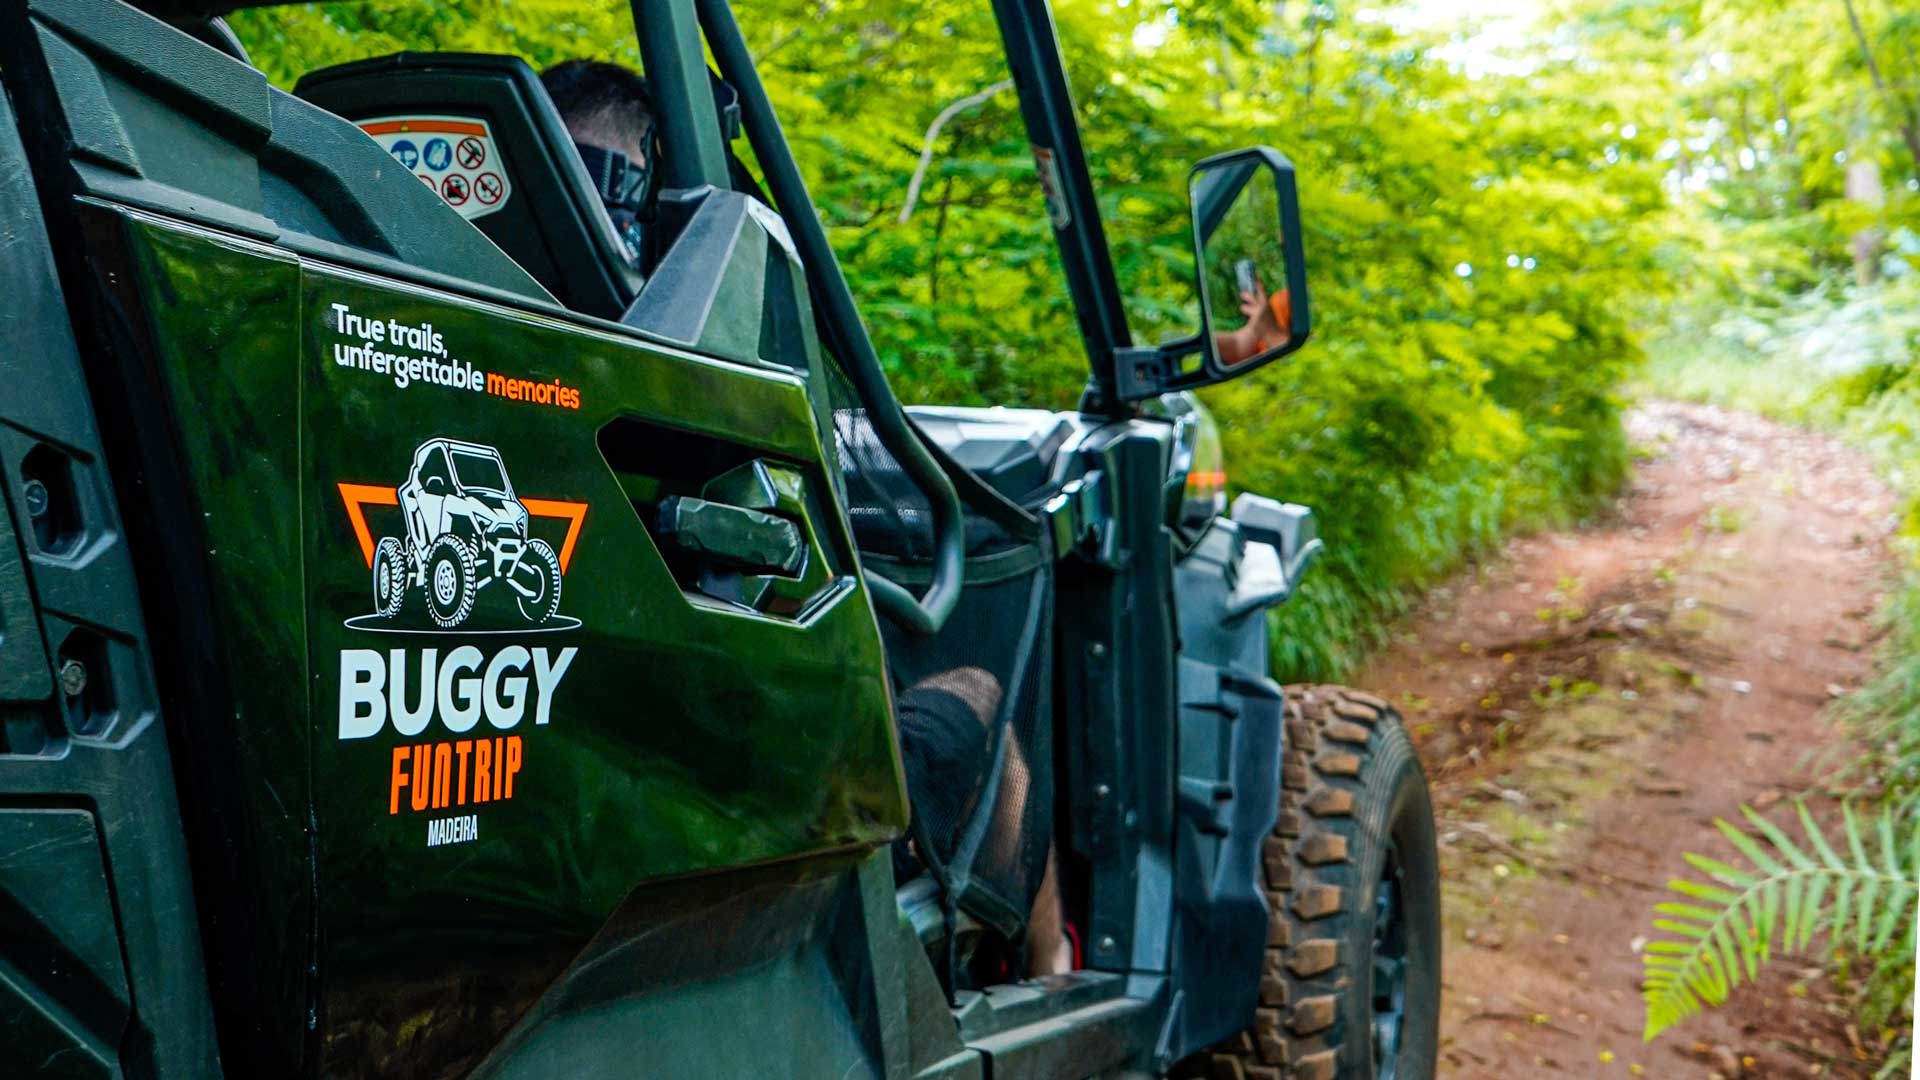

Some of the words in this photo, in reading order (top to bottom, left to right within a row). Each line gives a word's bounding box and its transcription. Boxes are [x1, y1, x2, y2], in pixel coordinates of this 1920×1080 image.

[331, 303, 386, 342] True
[388, 318, 449, 358] trails,
[487, 372, 580, 409] memories
[338, 645, 579, 740] BUGGY
[390, 736, 523, 815] FUNTRIP
[427, 815, 478, 848] MADEIRA
